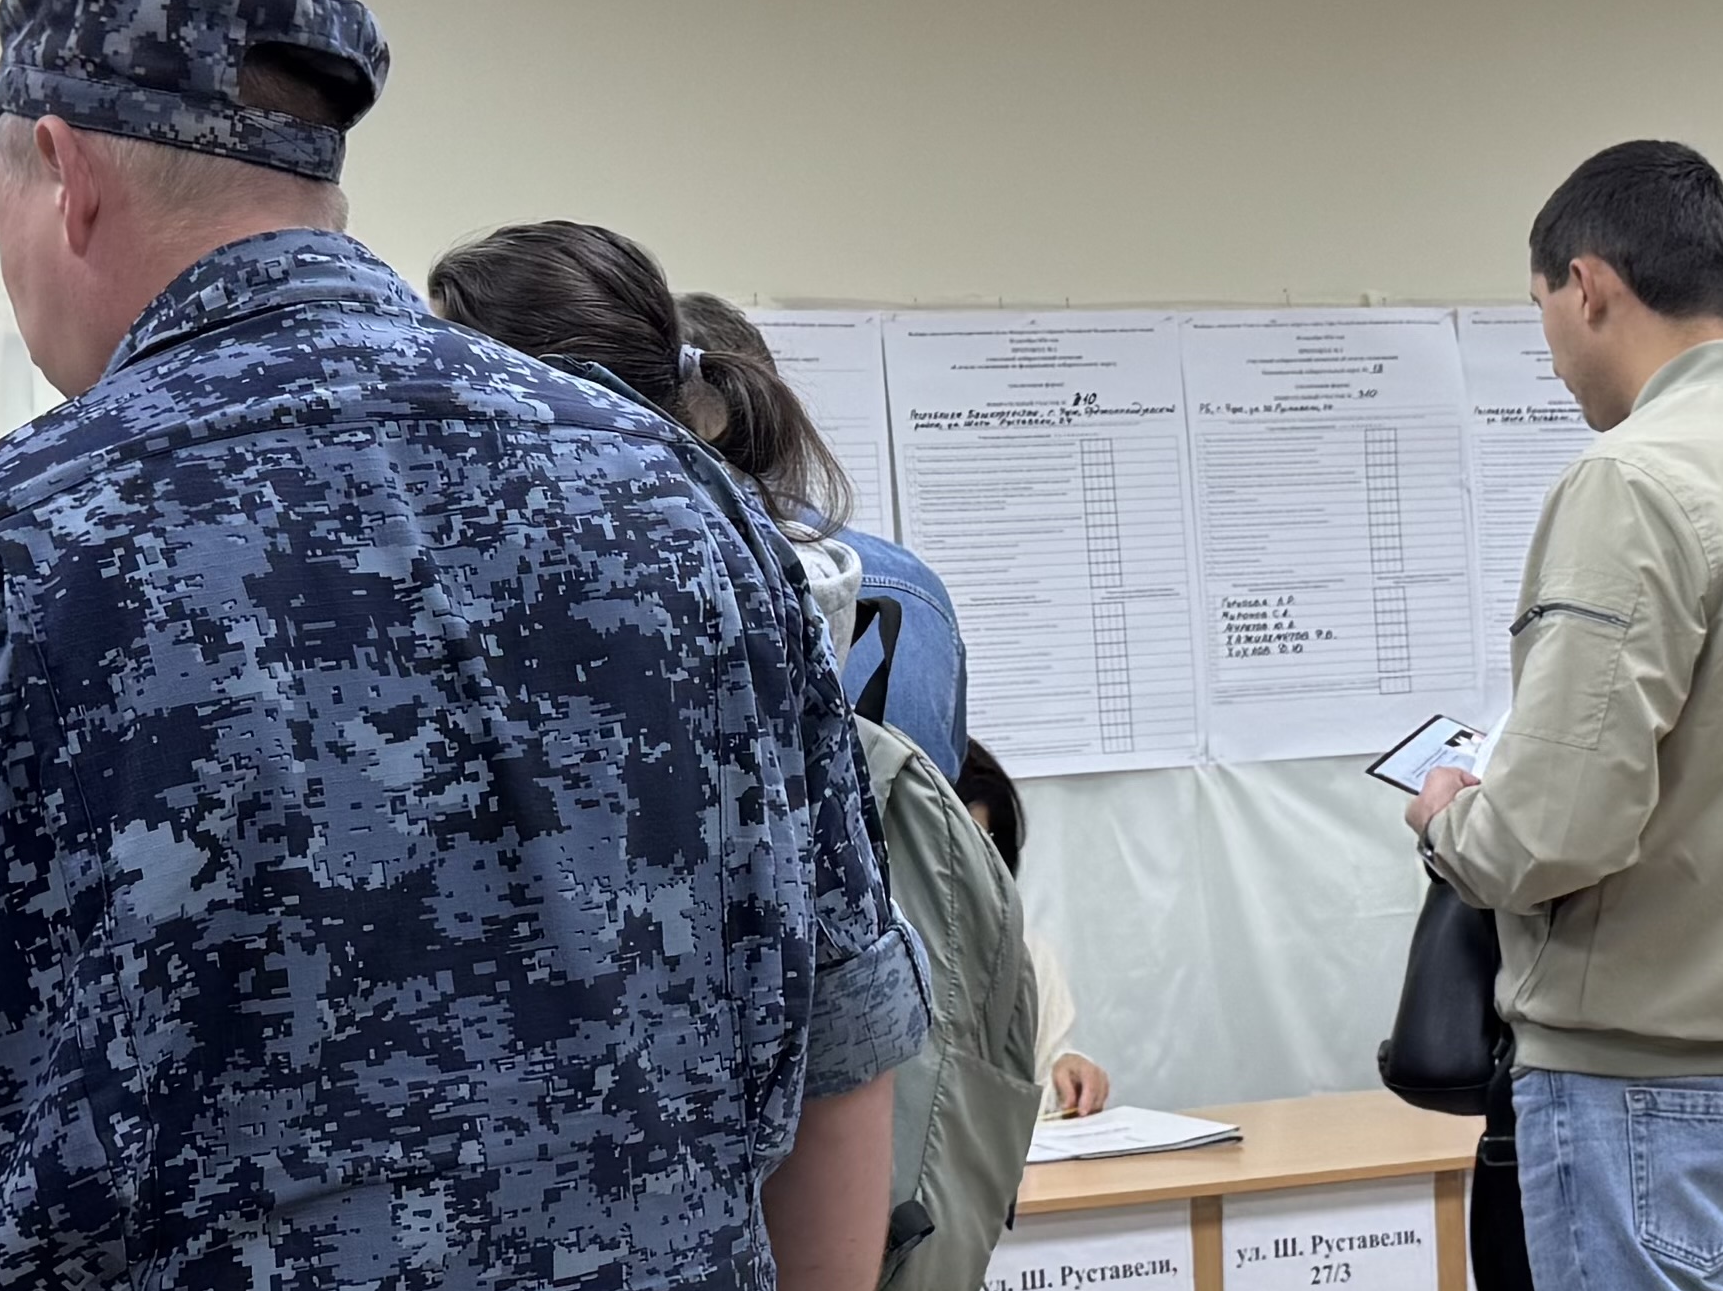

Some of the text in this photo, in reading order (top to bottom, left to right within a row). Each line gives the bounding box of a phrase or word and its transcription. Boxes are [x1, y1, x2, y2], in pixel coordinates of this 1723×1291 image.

[1235, 1230, 1422, 1269] ул. Ш. Руставели,
[1021, 1269, 1053, 1291] Ш.
[1060, 1259, 1178, 1290] Руставели,
[1310, 1262, 1352, 1285] 27/3
